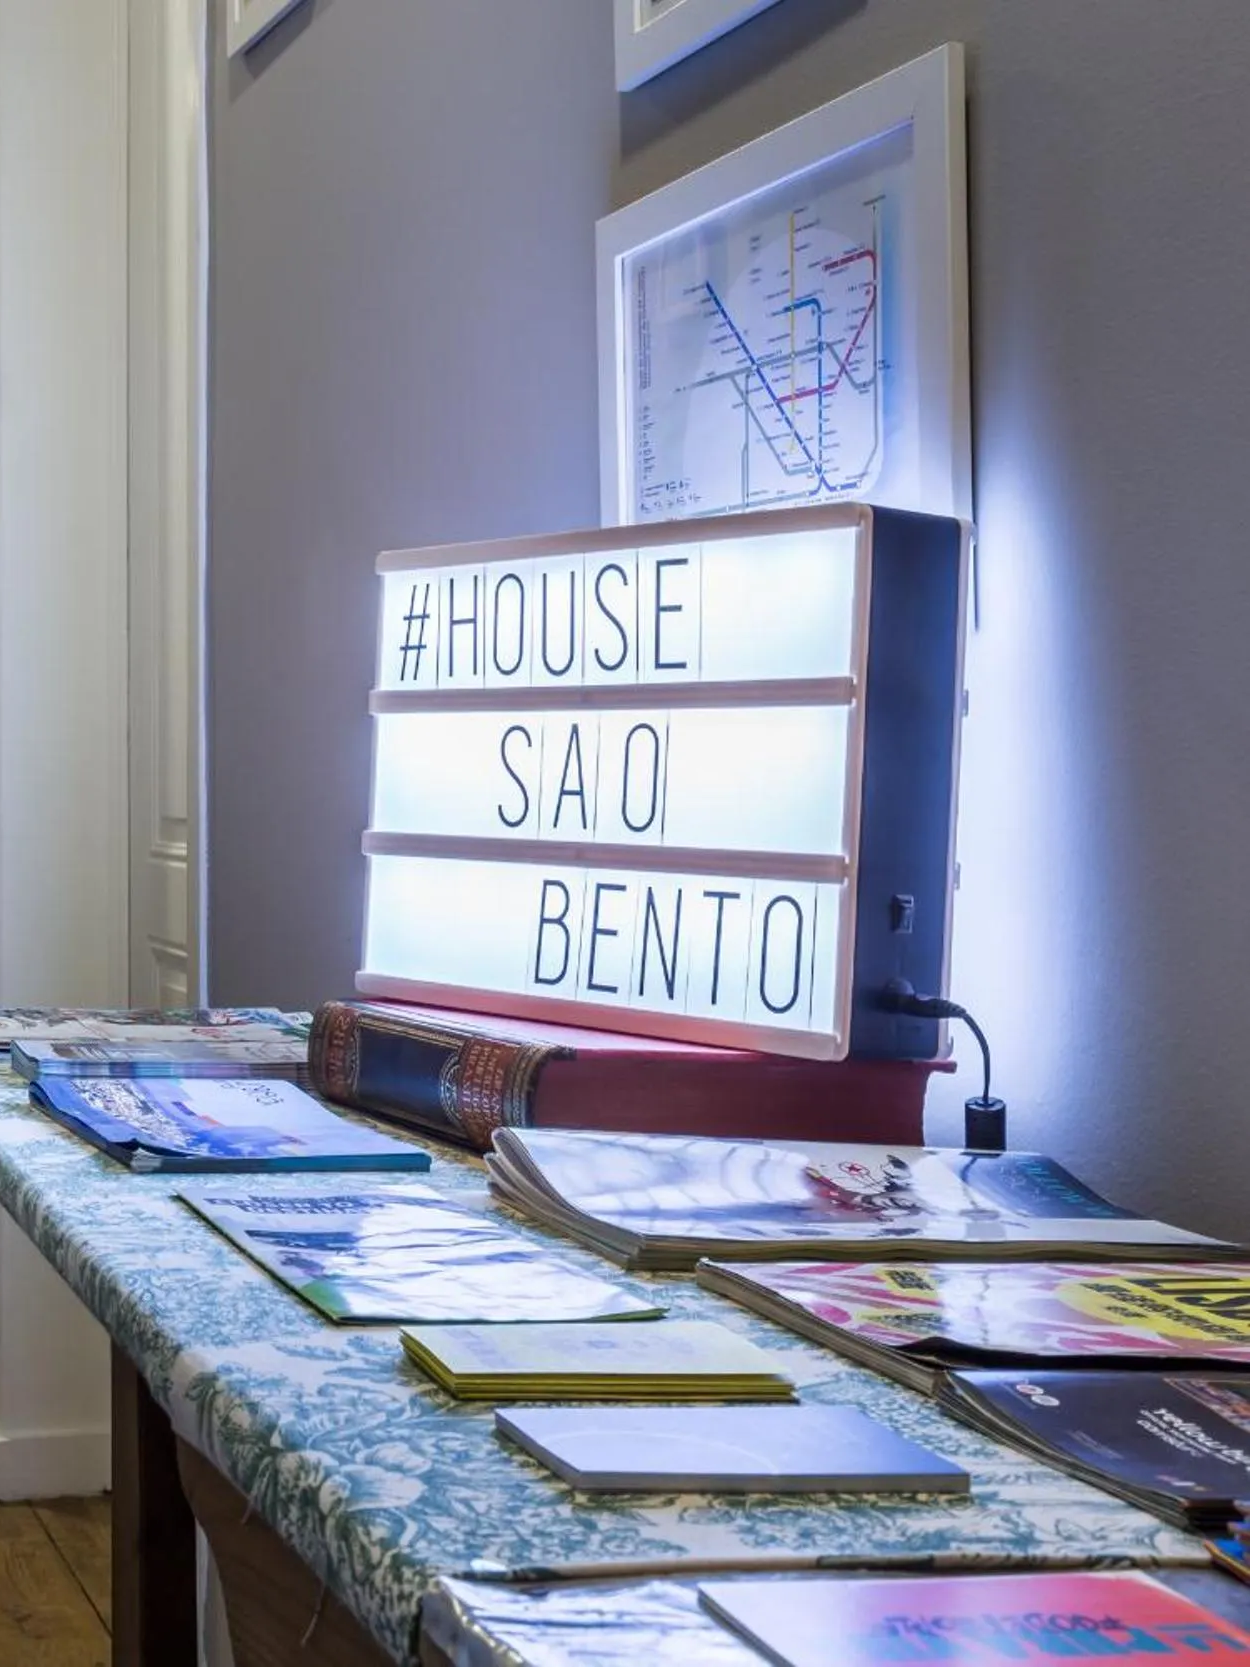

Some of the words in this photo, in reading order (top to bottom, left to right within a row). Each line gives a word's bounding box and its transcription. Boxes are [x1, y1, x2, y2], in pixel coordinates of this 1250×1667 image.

[399, 557, 690, 682] #HOUSE
[497, 722, 661, 833] SAO
[532, 878, 804, 1015] BENTO
